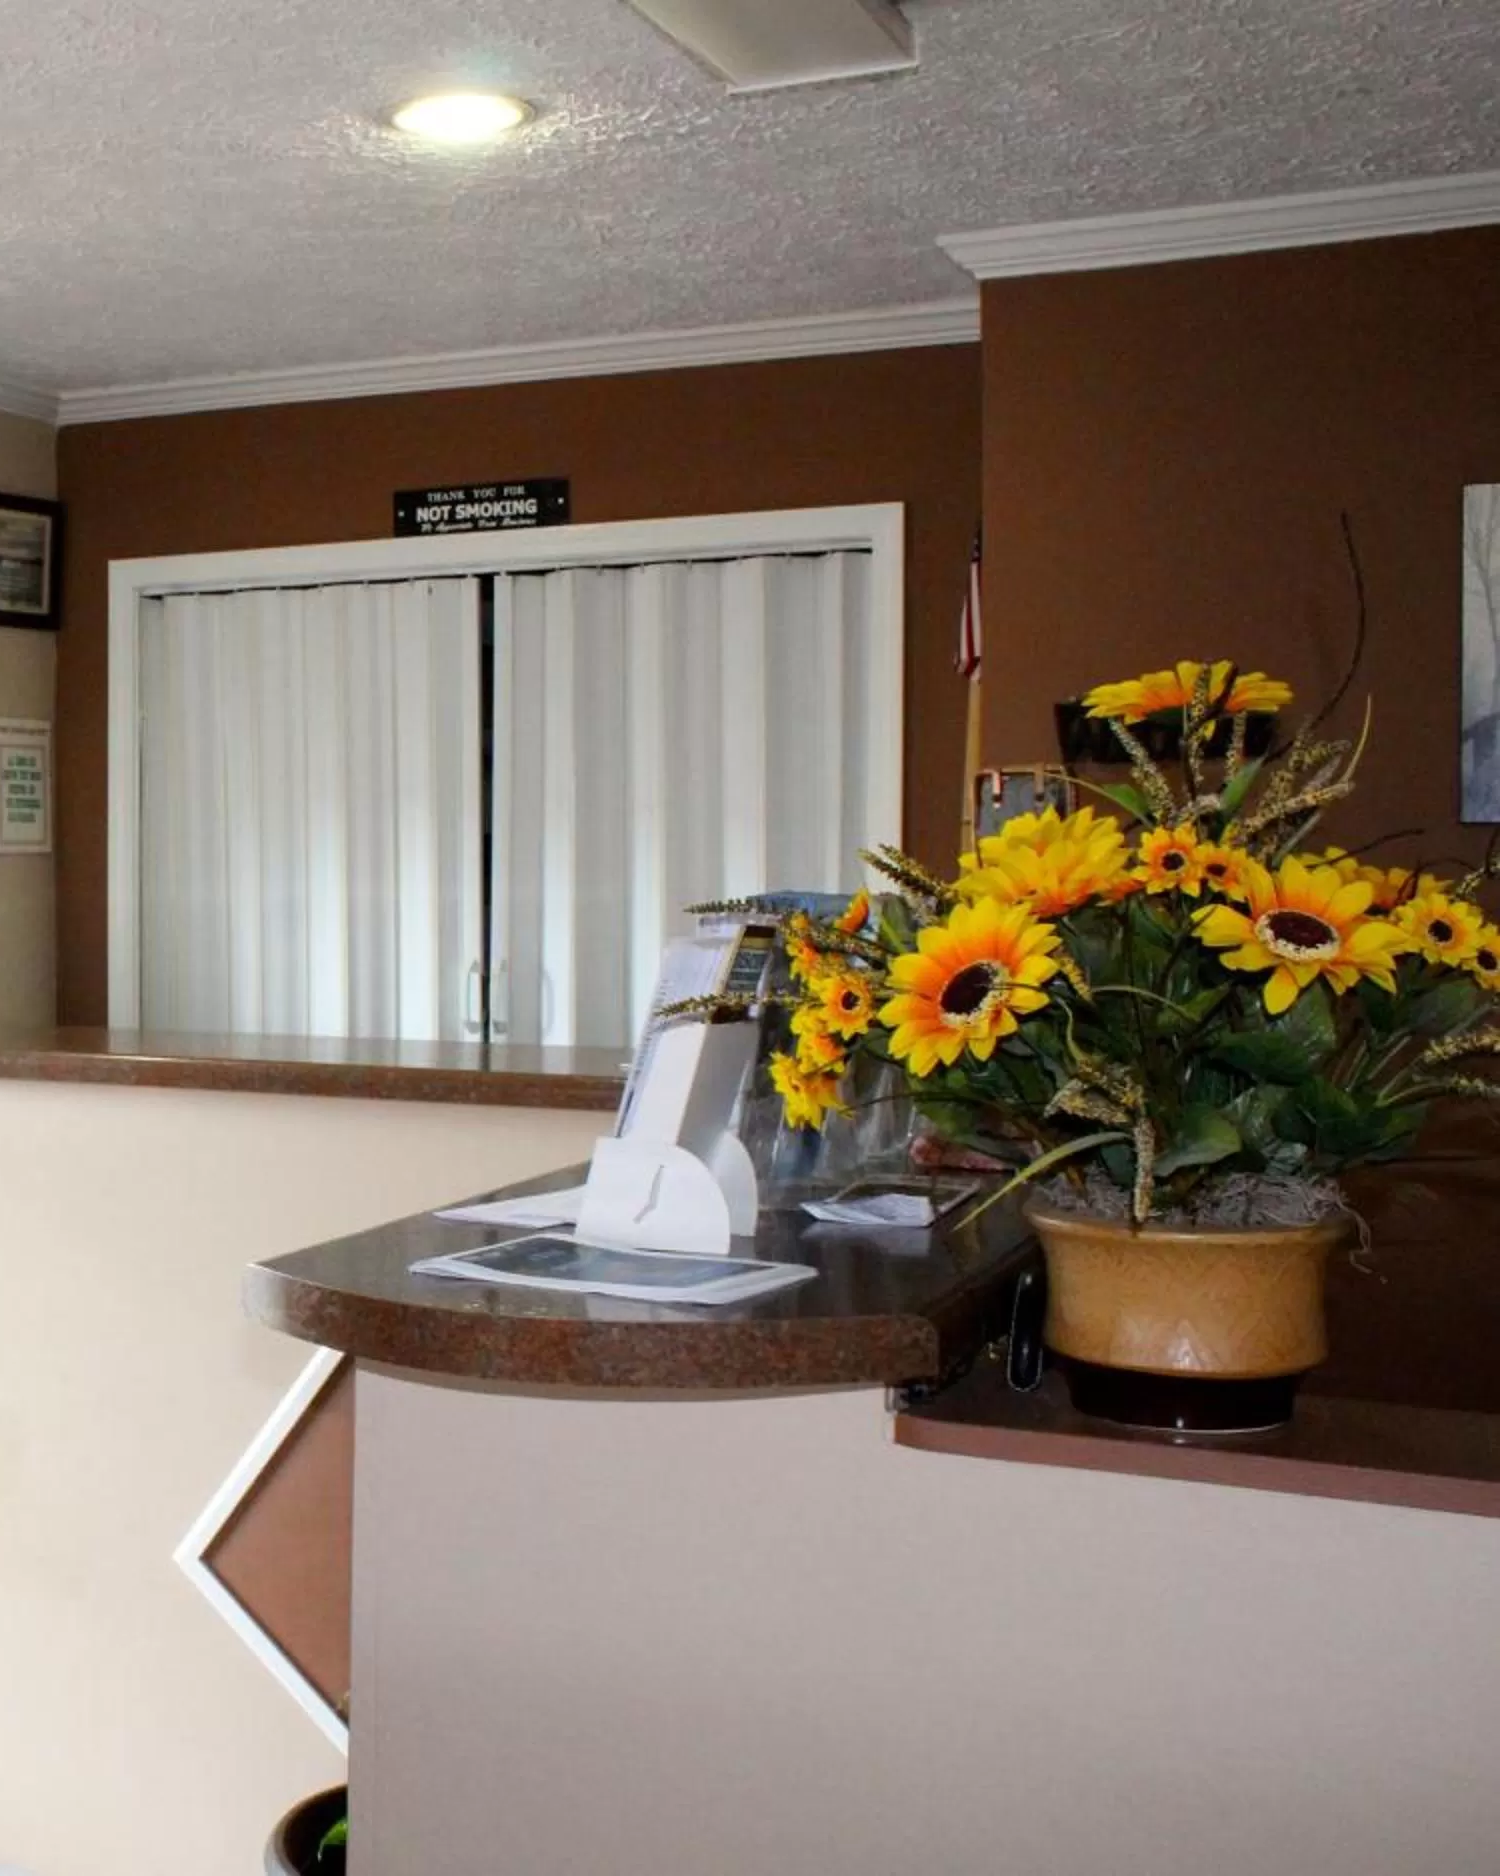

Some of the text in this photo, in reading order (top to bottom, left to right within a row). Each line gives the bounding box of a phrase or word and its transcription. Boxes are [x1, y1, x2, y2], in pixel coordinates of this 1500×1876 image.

[427, 485, 525, 503] THANK YOU FOR
[416, 498, 538, 523] NOT SMOKING
